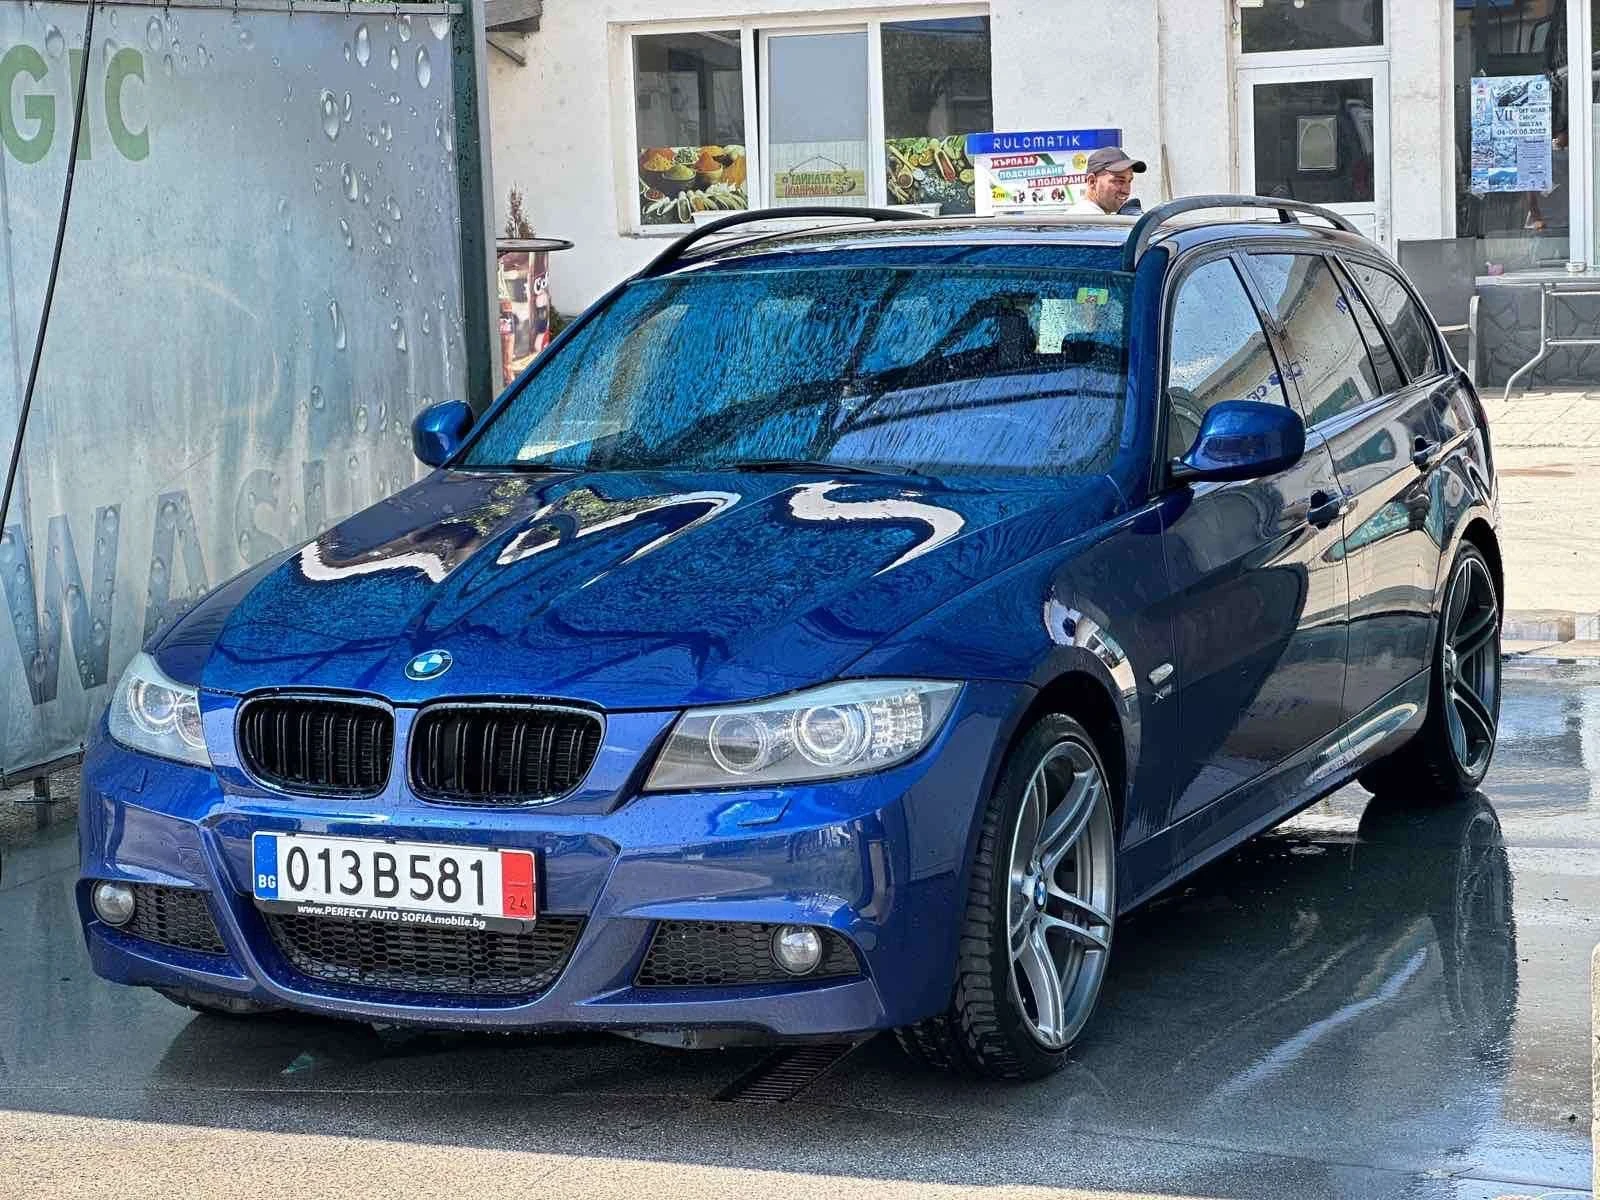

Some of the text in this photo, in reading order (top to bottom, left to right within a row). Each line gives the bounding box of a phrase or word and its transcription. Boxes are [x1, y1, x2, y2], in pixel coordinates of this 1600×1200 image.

[993, 135, 1080, 149] RULOMATIK
[994, 157, 1022, 167] КЪРПА
[1037, 175, 1086, 186] ПОЛИРАНЕ
[258, 874, 277, 889] BG
[508, 895, 528, 911] 24
[298, 904, 486, 930] www.PERFECT AUTO SOFIA.mobile.bg
